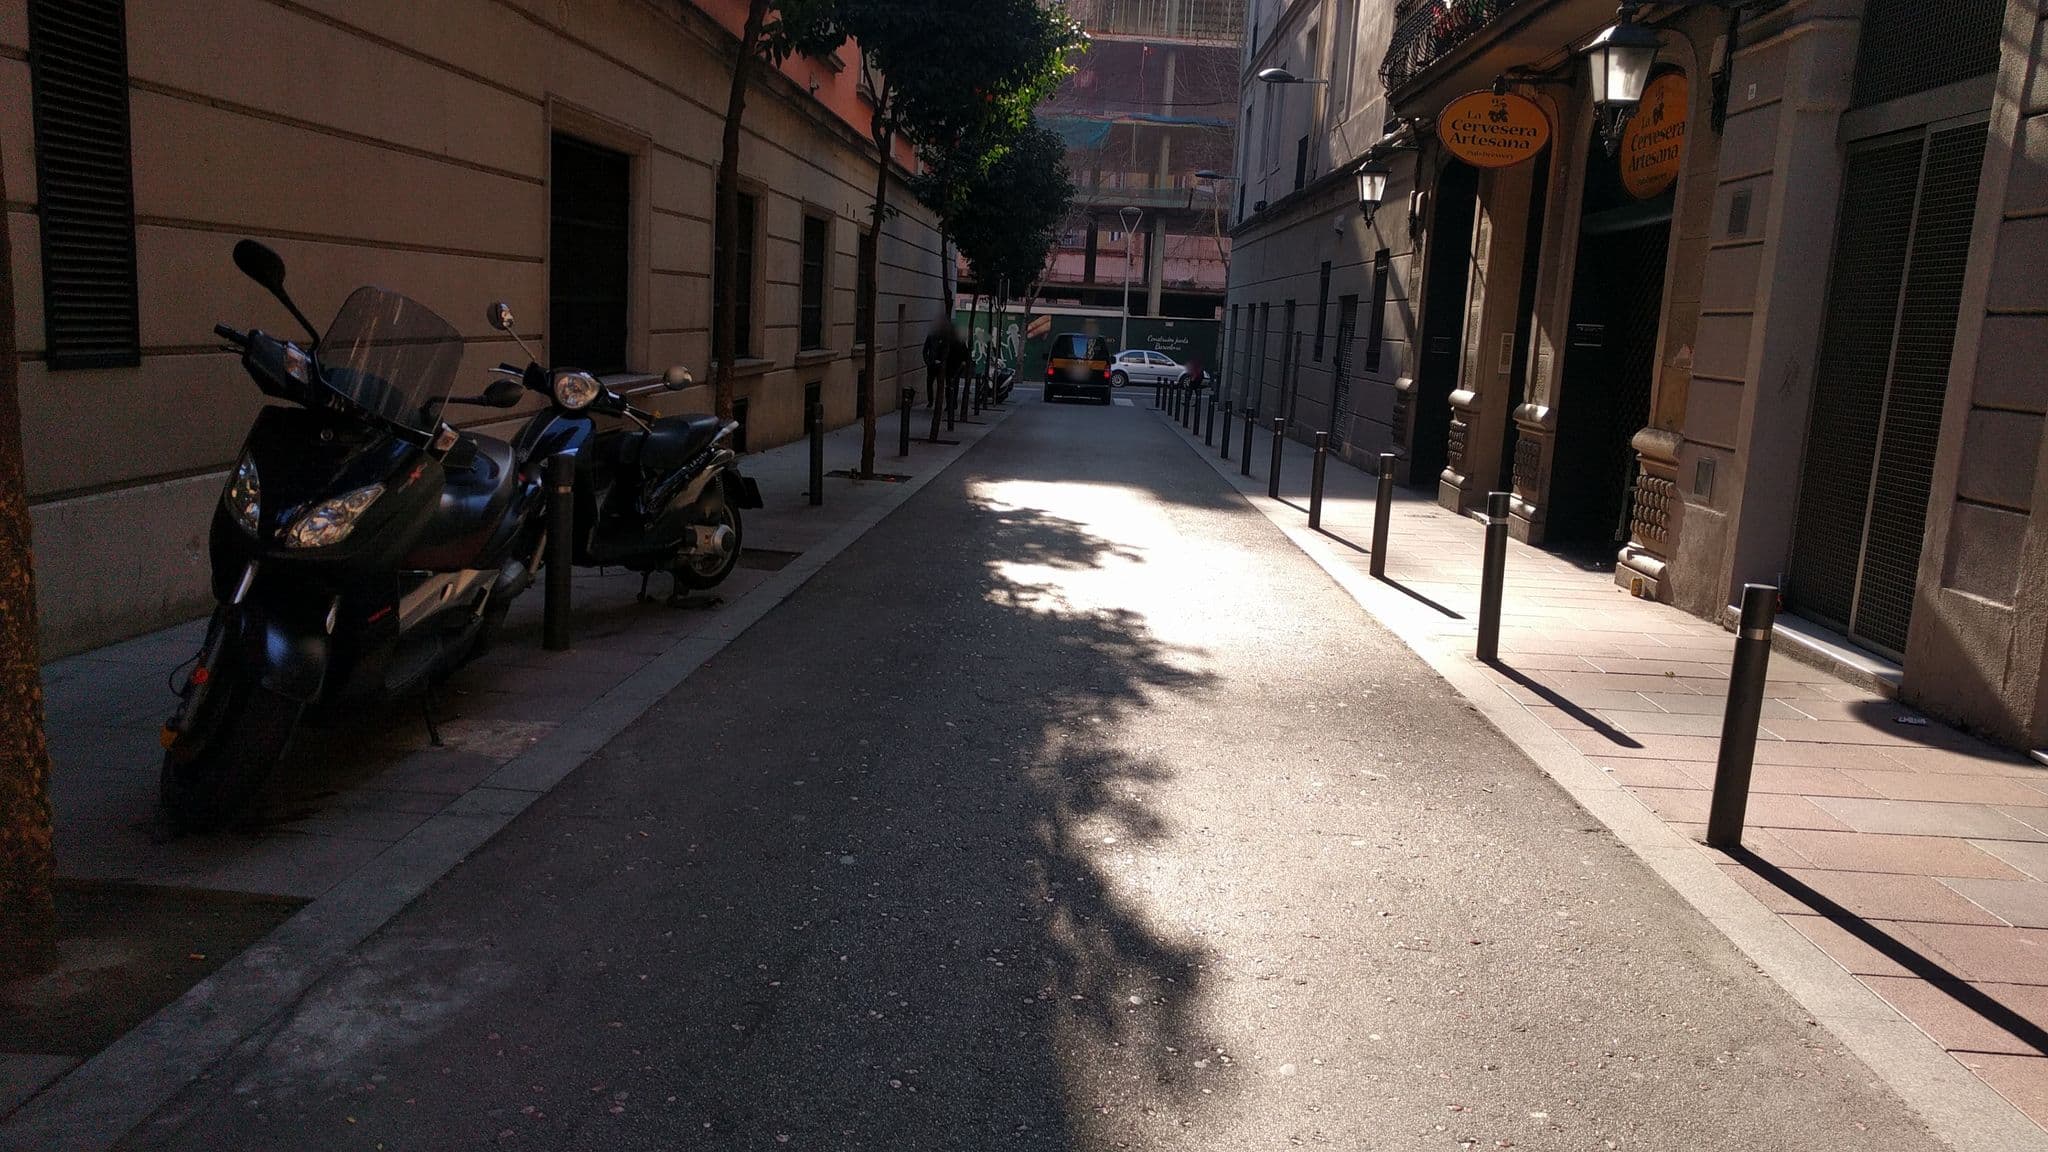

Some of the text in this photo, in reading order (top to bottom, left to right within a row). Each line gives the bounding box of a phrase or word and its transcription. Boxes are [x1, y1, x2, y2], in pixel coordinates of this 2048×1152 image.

[1467, 110, 1481, 119] La
[1451, 119, 1537, 137] Cervesera
[1631, 121, 1686, 152] Cervesera
[1449, 132, 1530, 149] Artesana
[1629, 145, 1679, 171] Artesana
